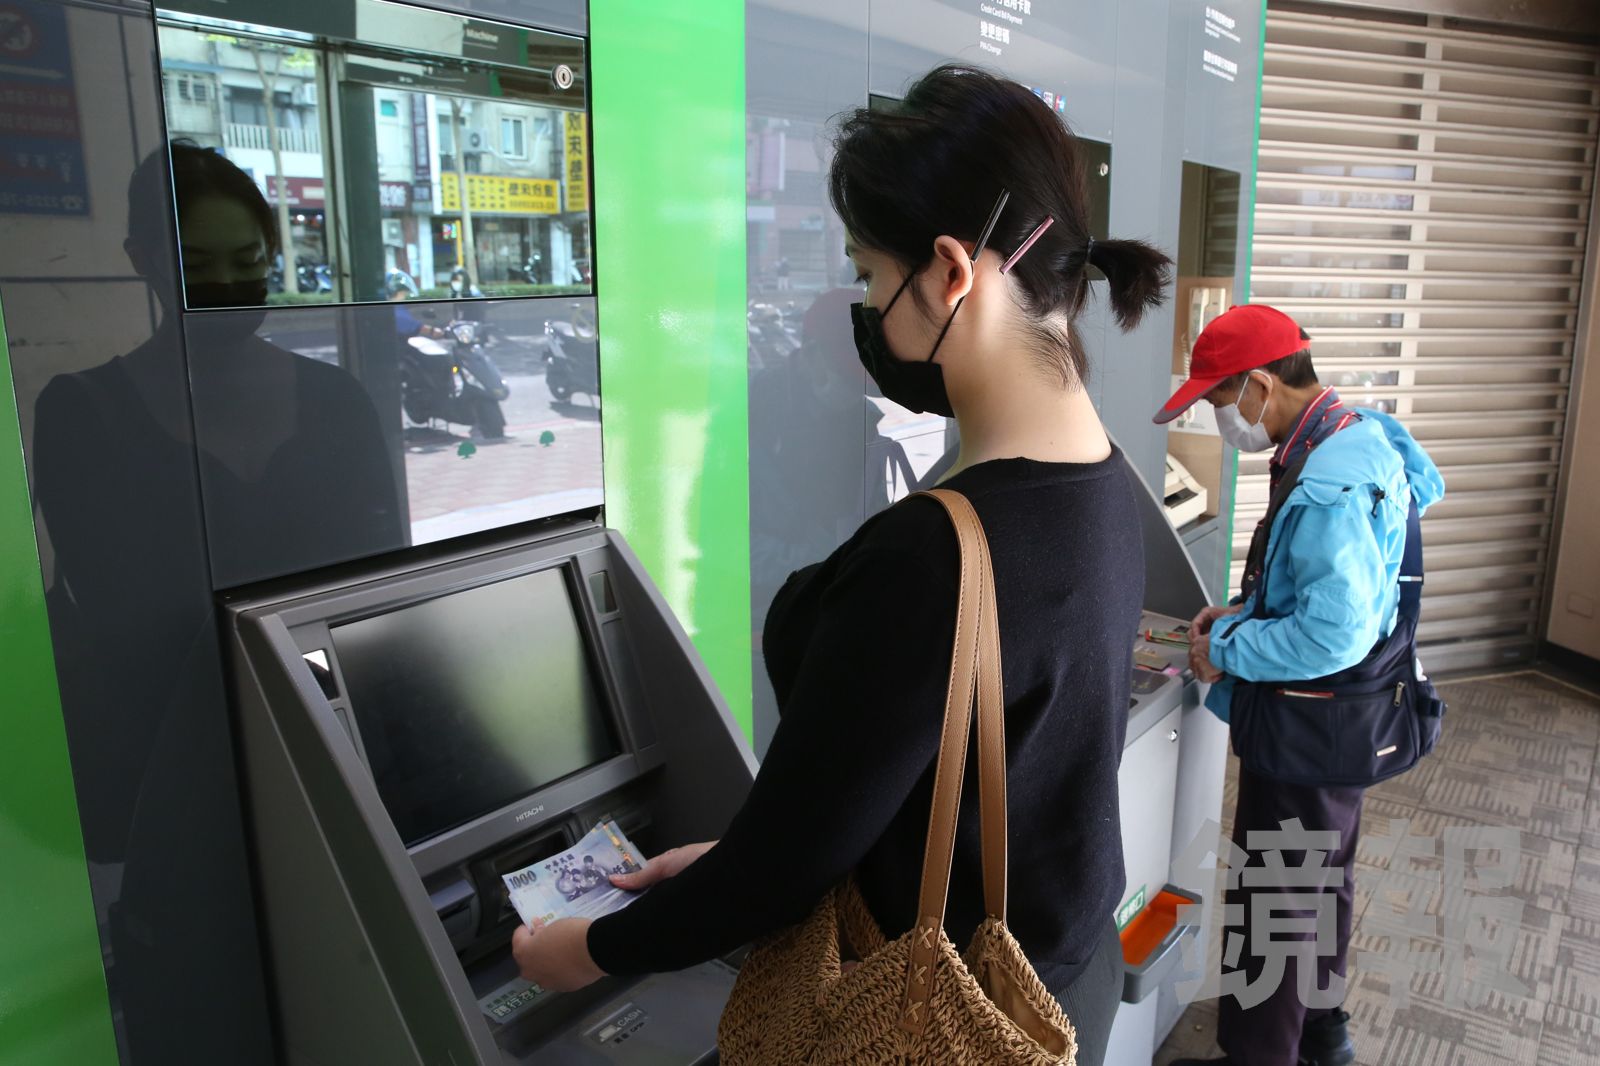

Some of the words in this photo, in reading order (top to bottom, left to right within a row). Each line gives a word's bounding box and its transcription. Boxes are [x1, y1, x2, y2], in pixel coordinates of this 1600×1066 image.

[980, 20, 1010, 45] 變更密碼
[515, 804, 545, 823] HITACHI
[508, 870, 537, 890] 1000
